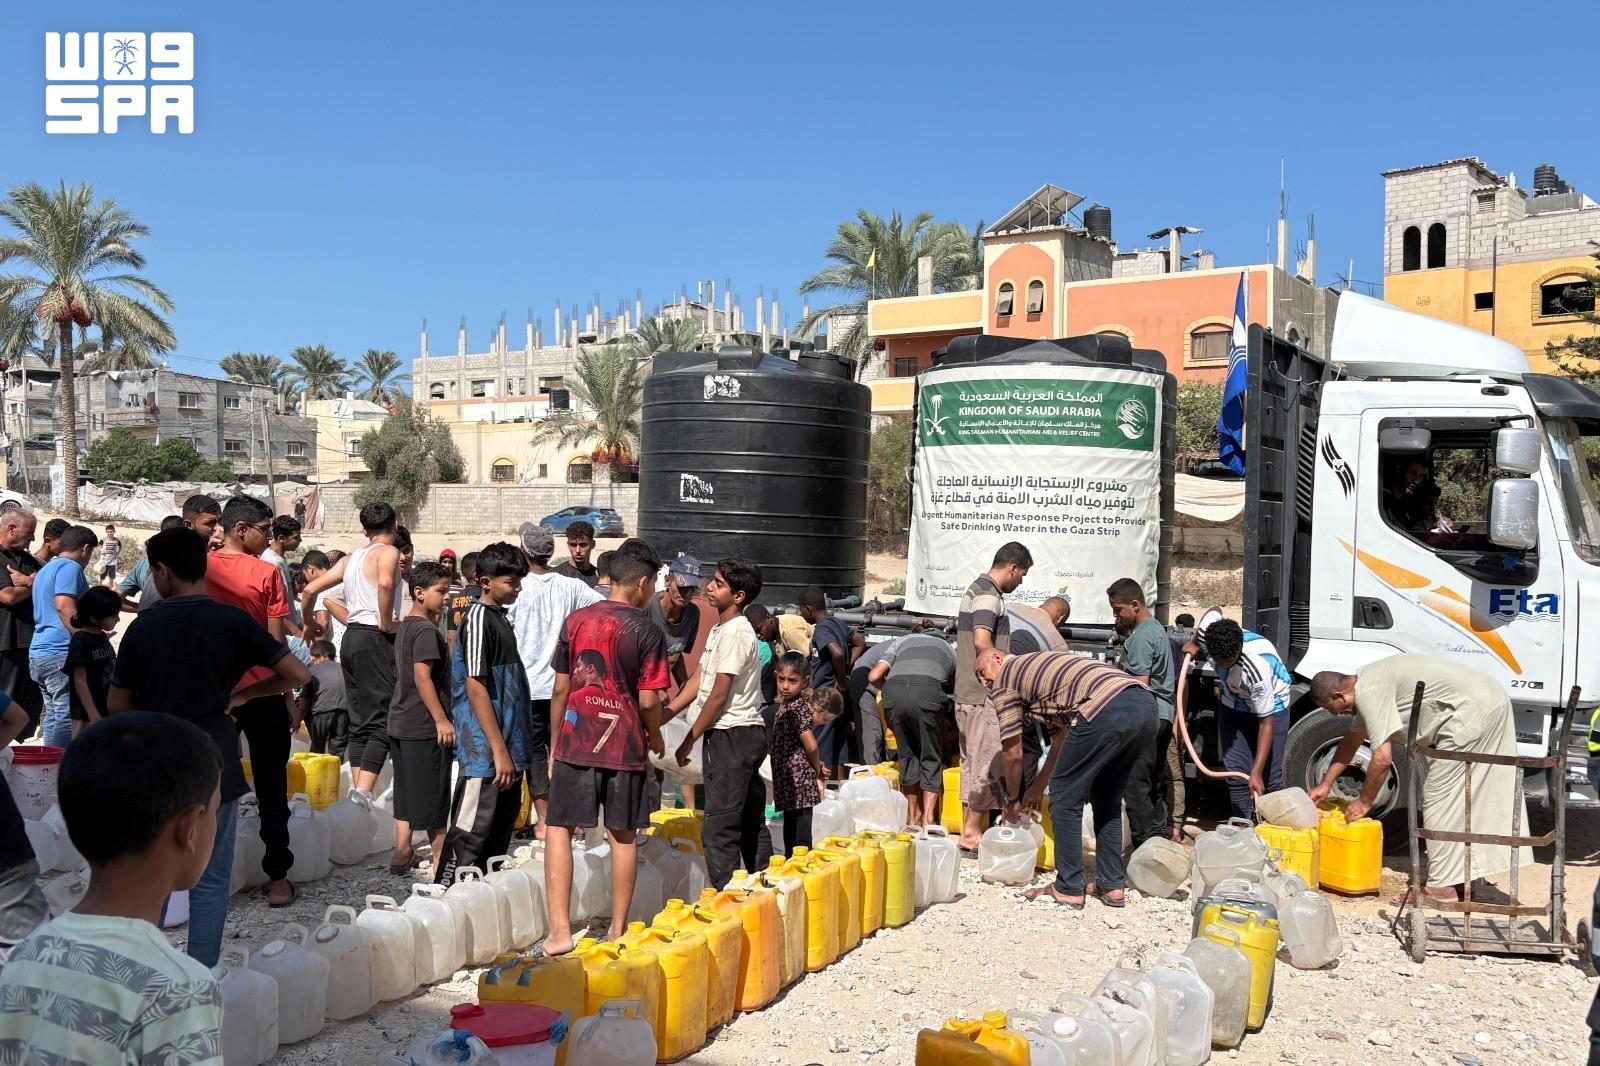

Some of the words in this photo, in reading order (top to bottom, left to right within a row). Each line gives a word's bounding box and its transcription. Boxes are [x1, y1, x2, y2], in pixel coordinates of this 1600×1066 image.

[960, 391, 1010, 404] السعودية
[1013, 389, 1053, 403] العربية
[1057, 390, 1102, 403] المملكة
[959, 406, 1005, 416] KINGDOM
[1009, 406, 1022, 415] OF
[1025, 406, 1059, 416] SAUDI
[1062, 407, 1101, 417] ARABIA
[937, 475, 969, 489] العاجلة
[971, 475, 1022, 490] الإنسانية
[1025, 476, 1084, 492] الإستجابة
[1087, 479, 1127, 493] مشروع
[931, 491, 943, 505] غزة
[945, 491, 971, 505] قطاع
[973, 492, 993, 507] في
[1033, 493, 1072, 507] الشرب
[1075, 495, 1101, 509] مياه
[1103, 497, 1135, 510] لتوفير
[921, 510, 943, 520] Urgent
[944, 511, 1005, 520] Humanitarian
[1007, 512, 1060, 522] Response
[1062, 514, 1100, 524] Project
[1103, 515, 1113, 523] to
[1115, 516, 1146, 525] Provide
[940, 521, 960, 530] Safe
[961, 522, 1001, 533] Drinking
[1003, 523, 1035, 532] Water
[1037, 525, 1047, 533] in
[1049, 525, 1068, 533] the
[1070, 526, 1095, 535] Gaza
[1097, 526, 1120, 538] Strip
[1489, 588, 1559, 615] Eta
[592, 711, 620, 753] 7
